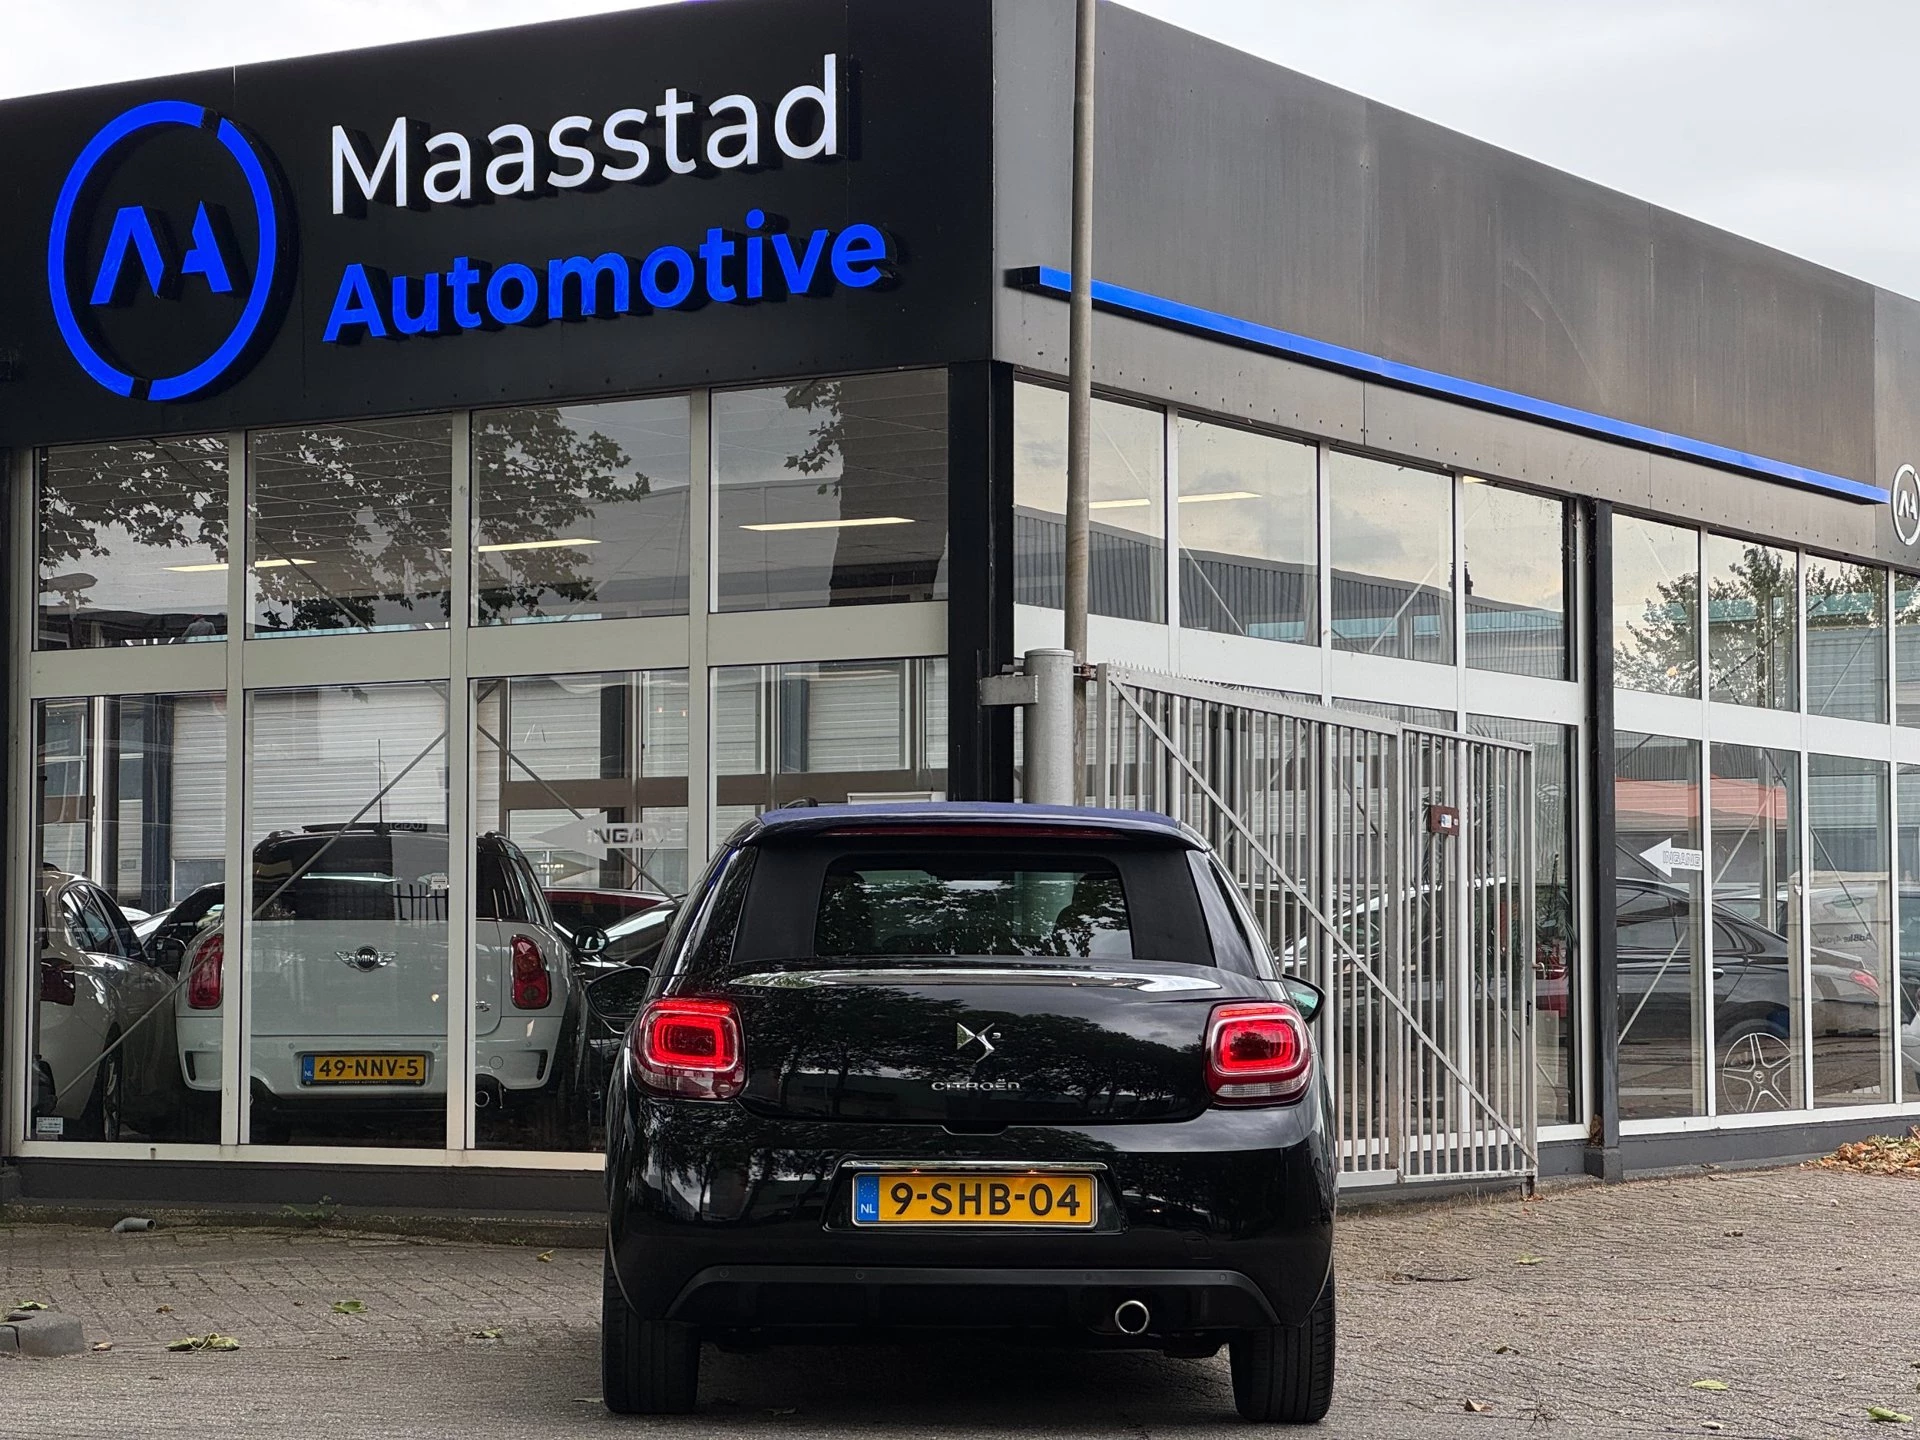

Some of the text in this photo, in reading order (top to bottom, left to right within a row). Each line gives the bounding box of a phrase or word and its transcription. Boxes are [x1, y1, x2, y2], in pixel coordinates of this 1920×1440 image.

[331, 53, 838, 215] Maasstad
[322, 208, 888, 342] Automotive
[1662, 850, 1701, 867] INGANG
[318, 1059, 419, 1077] 49-NNV-5
[860, 1182, 1081, 1217] NL 9-SHB-04
